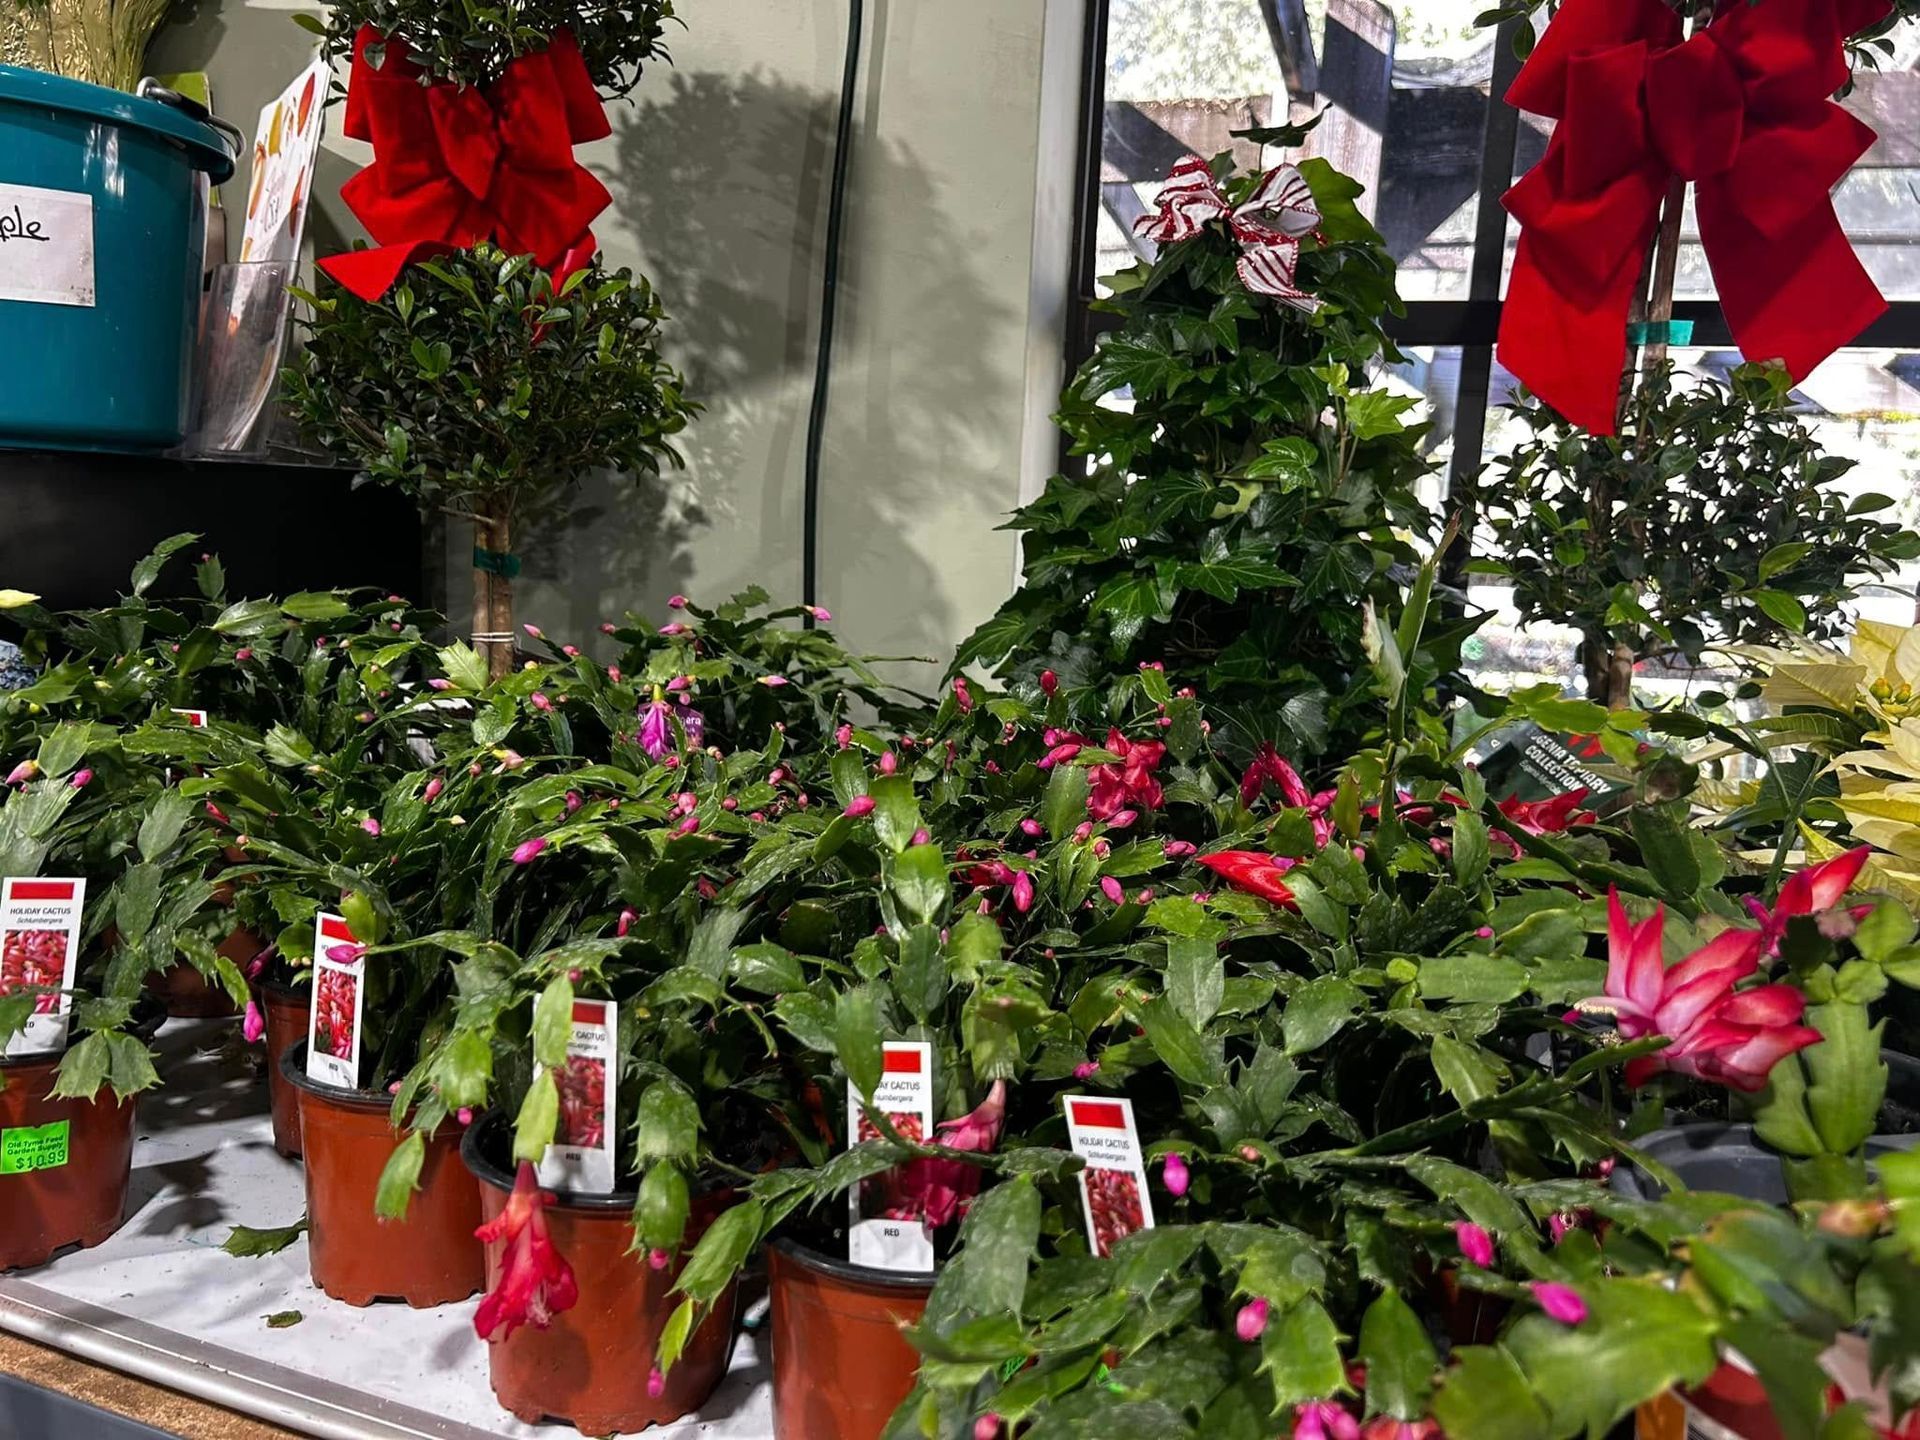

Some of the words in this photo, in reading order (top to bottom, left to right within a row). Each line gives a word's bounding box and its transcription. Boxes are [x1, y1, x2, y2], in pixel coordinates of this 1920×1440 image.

[1525, 745, 1585, 792] COLLECTION
[10, 907, 41, 915] HOLIDAY
[42, 907, 71, 915] CACTUS
[576, 1030, 606, 1041] CACTUS
[890, 1081, 921, 1090] CACTUS
[7, 1141, 22, 1149] Old
[1079, 1136, 1103, 1147] HOLIDAY
[1105, 1138, 1129, 1150] CACTUS
[16, 1150, 65, 1170] $10.99
[884, 1227, 900, 1238] RED
